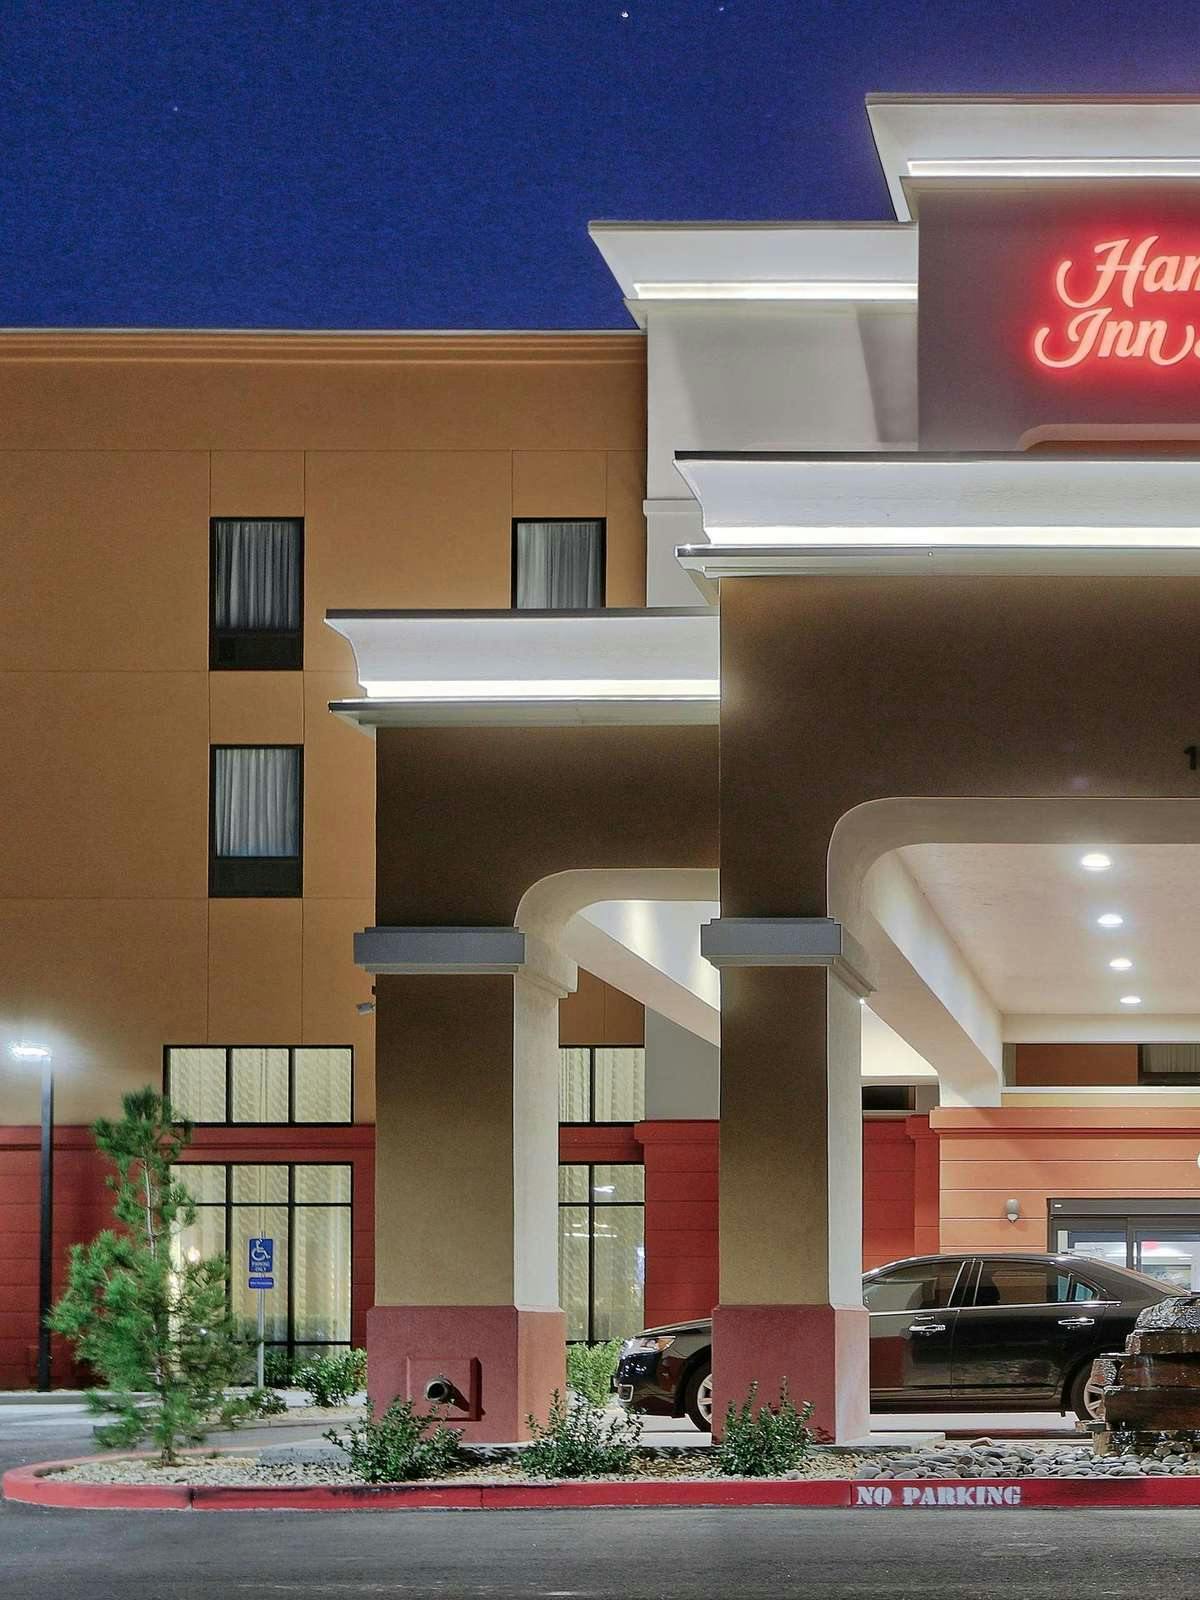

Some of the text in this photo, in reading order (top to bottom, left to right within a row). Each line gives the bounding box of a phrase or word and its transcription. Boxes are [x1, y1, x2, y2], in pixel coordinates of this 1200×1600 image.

[1034, 307, 1194, 368] Inn
[856, 1486, 1022, 1506] NO PARKING
